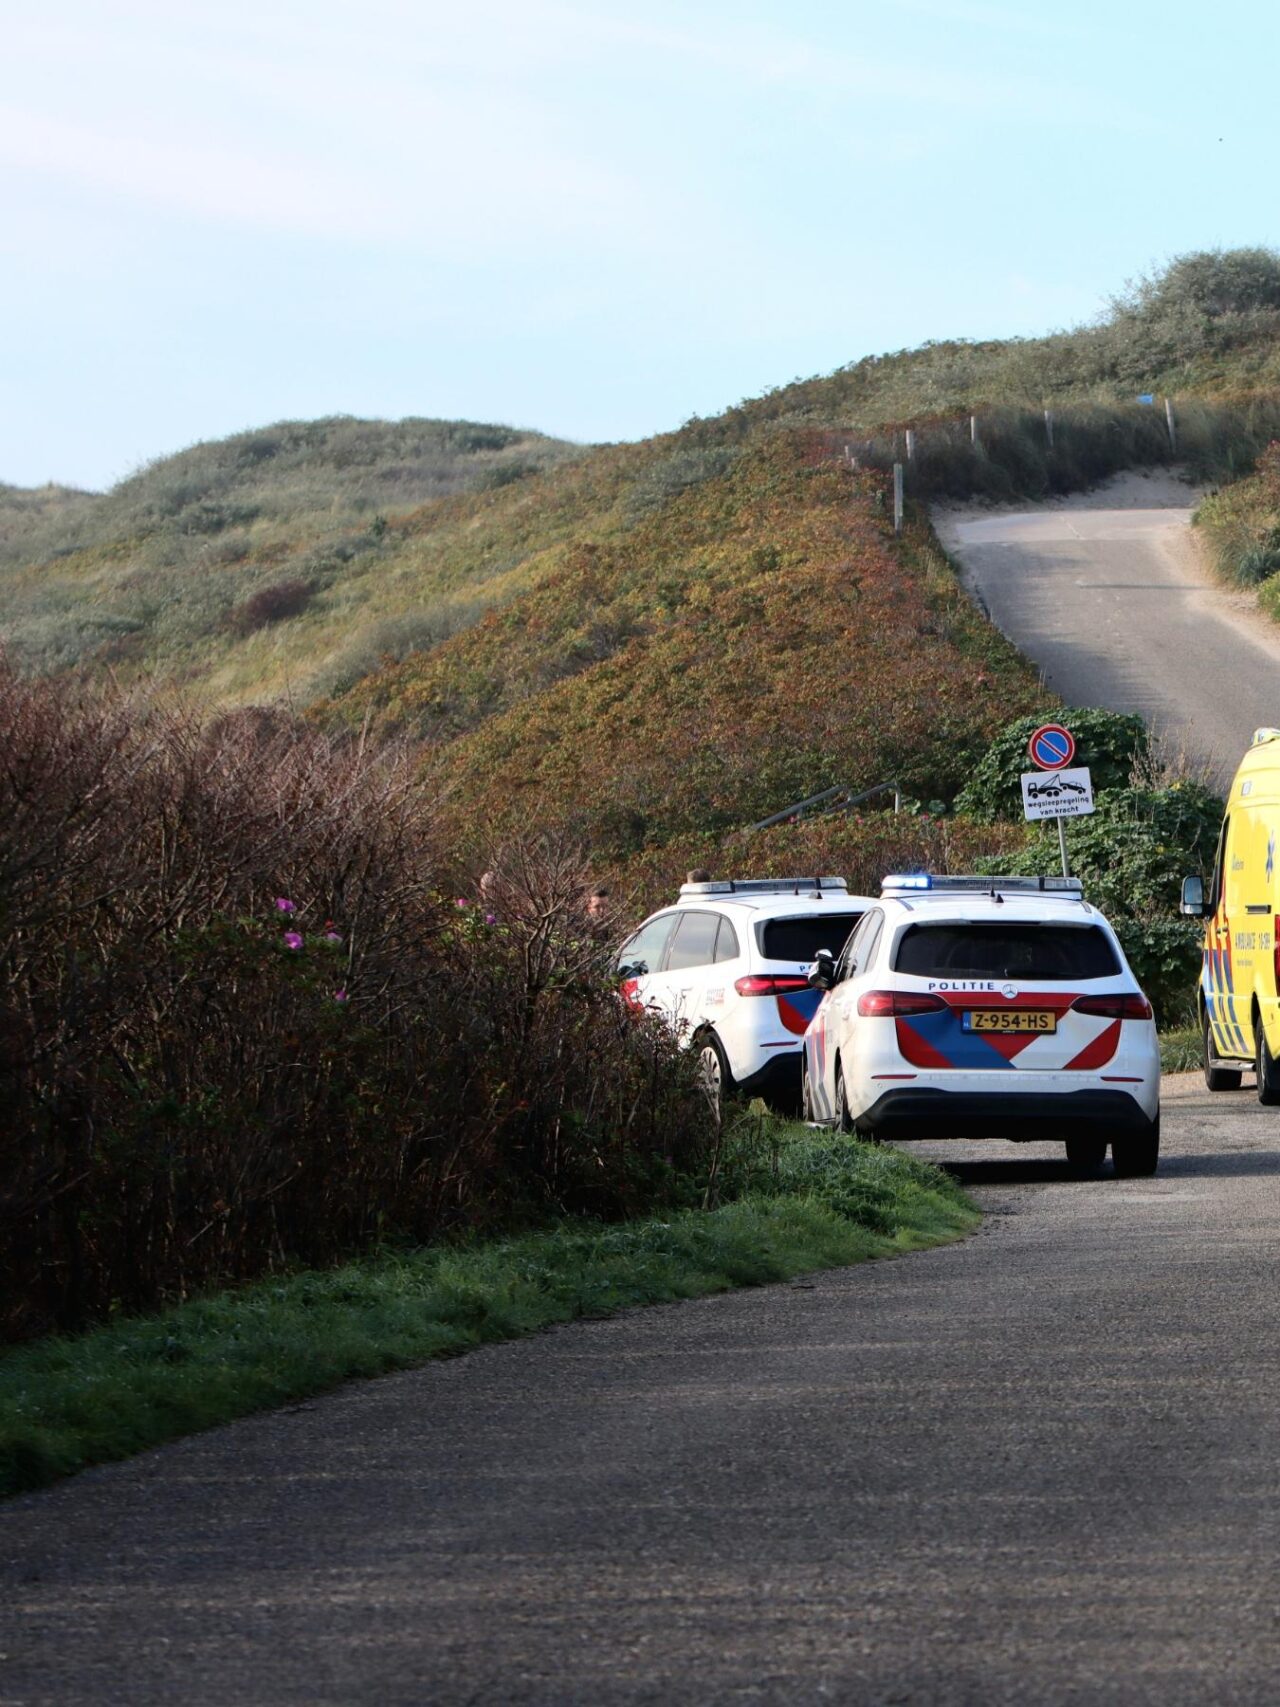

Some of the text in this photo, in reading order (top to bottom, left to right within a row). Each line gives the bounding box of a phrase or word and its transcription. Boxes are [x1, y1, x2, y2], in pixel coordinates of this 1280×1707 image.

[1027, 796, 1090, 809] wegsleepregeling
[1039, 805, 1079, 816] van kracht
[928, 981, 995, 991] POLITIE
[974, 1013, 1049, 1029] Z-954-HS
